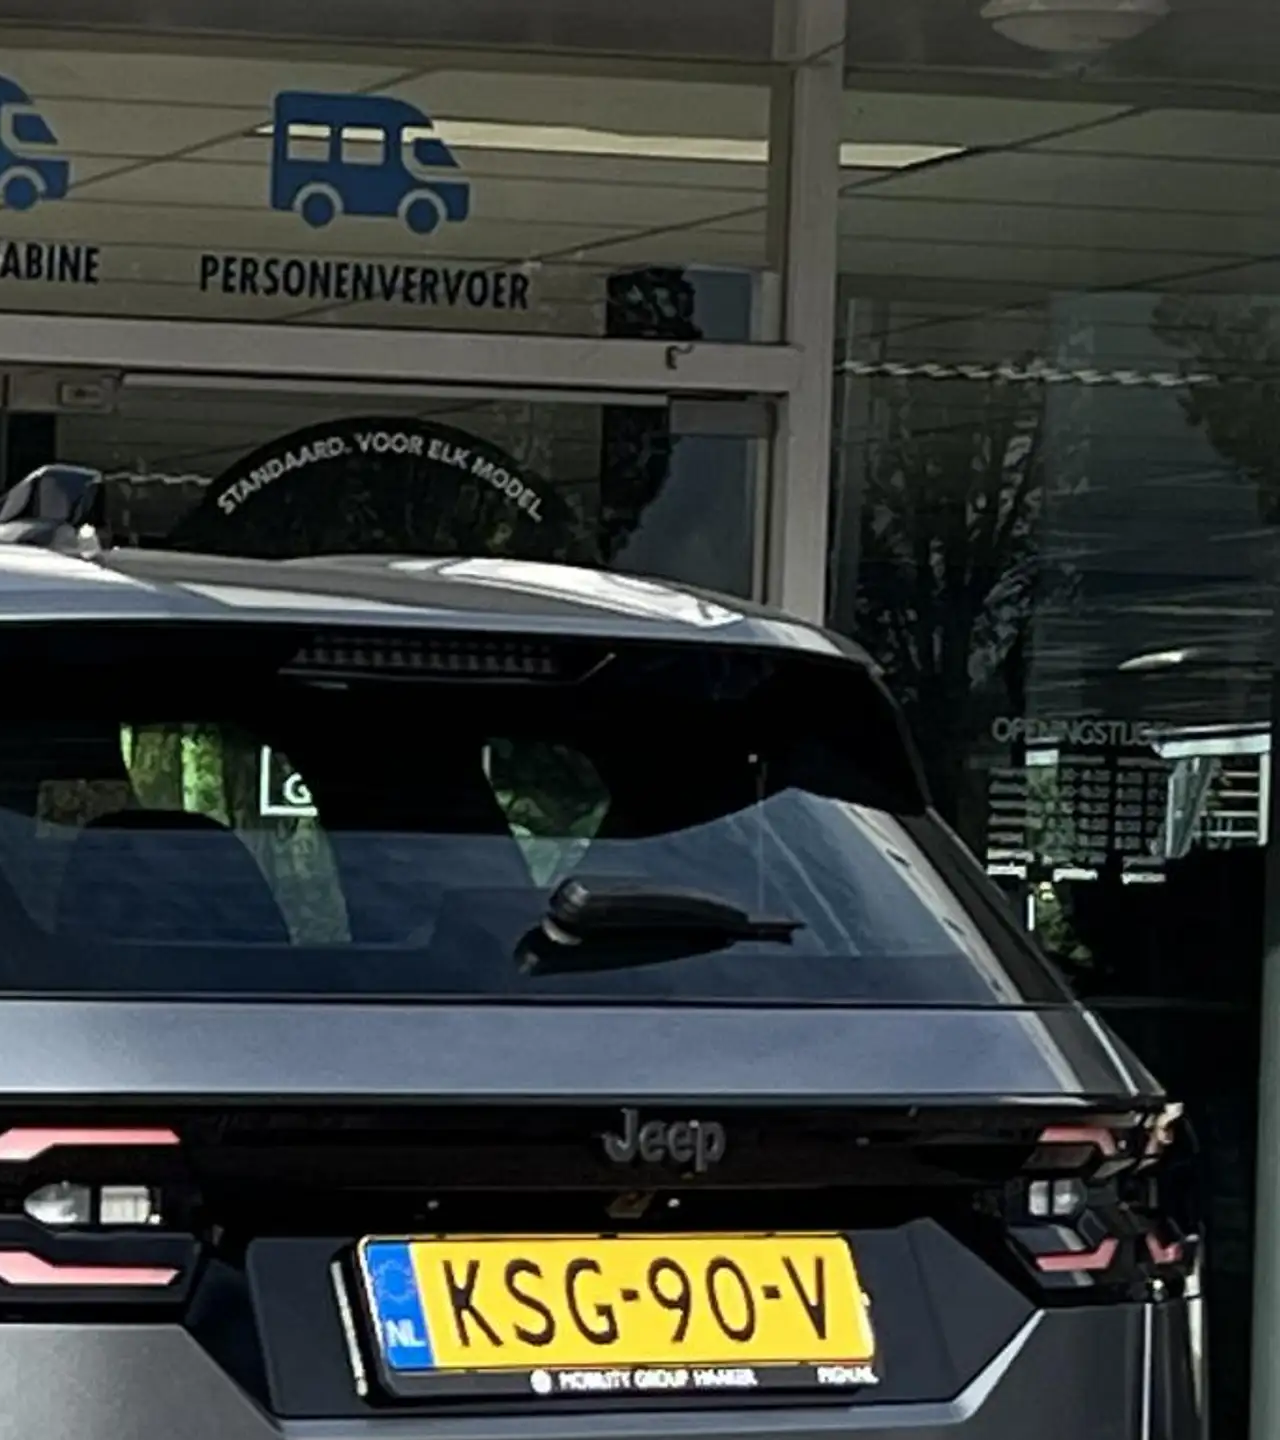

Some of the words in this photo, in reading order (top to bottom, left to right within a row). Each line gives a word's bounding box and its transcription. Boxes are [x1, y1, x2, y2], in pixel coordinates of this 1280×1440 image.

[199, 254, 529, 310] PERSONENVERVOER
[353, 432, 424, 456] VOOR
[426, 439, 471, 470] ELK
[602, 1108, 726, 1172] Jeep
[442, 1256, 828, 1349] KSG-90-V
[385, 1318, 424, 1349] NL
[634, 1368, 689, 1390] GROUP
